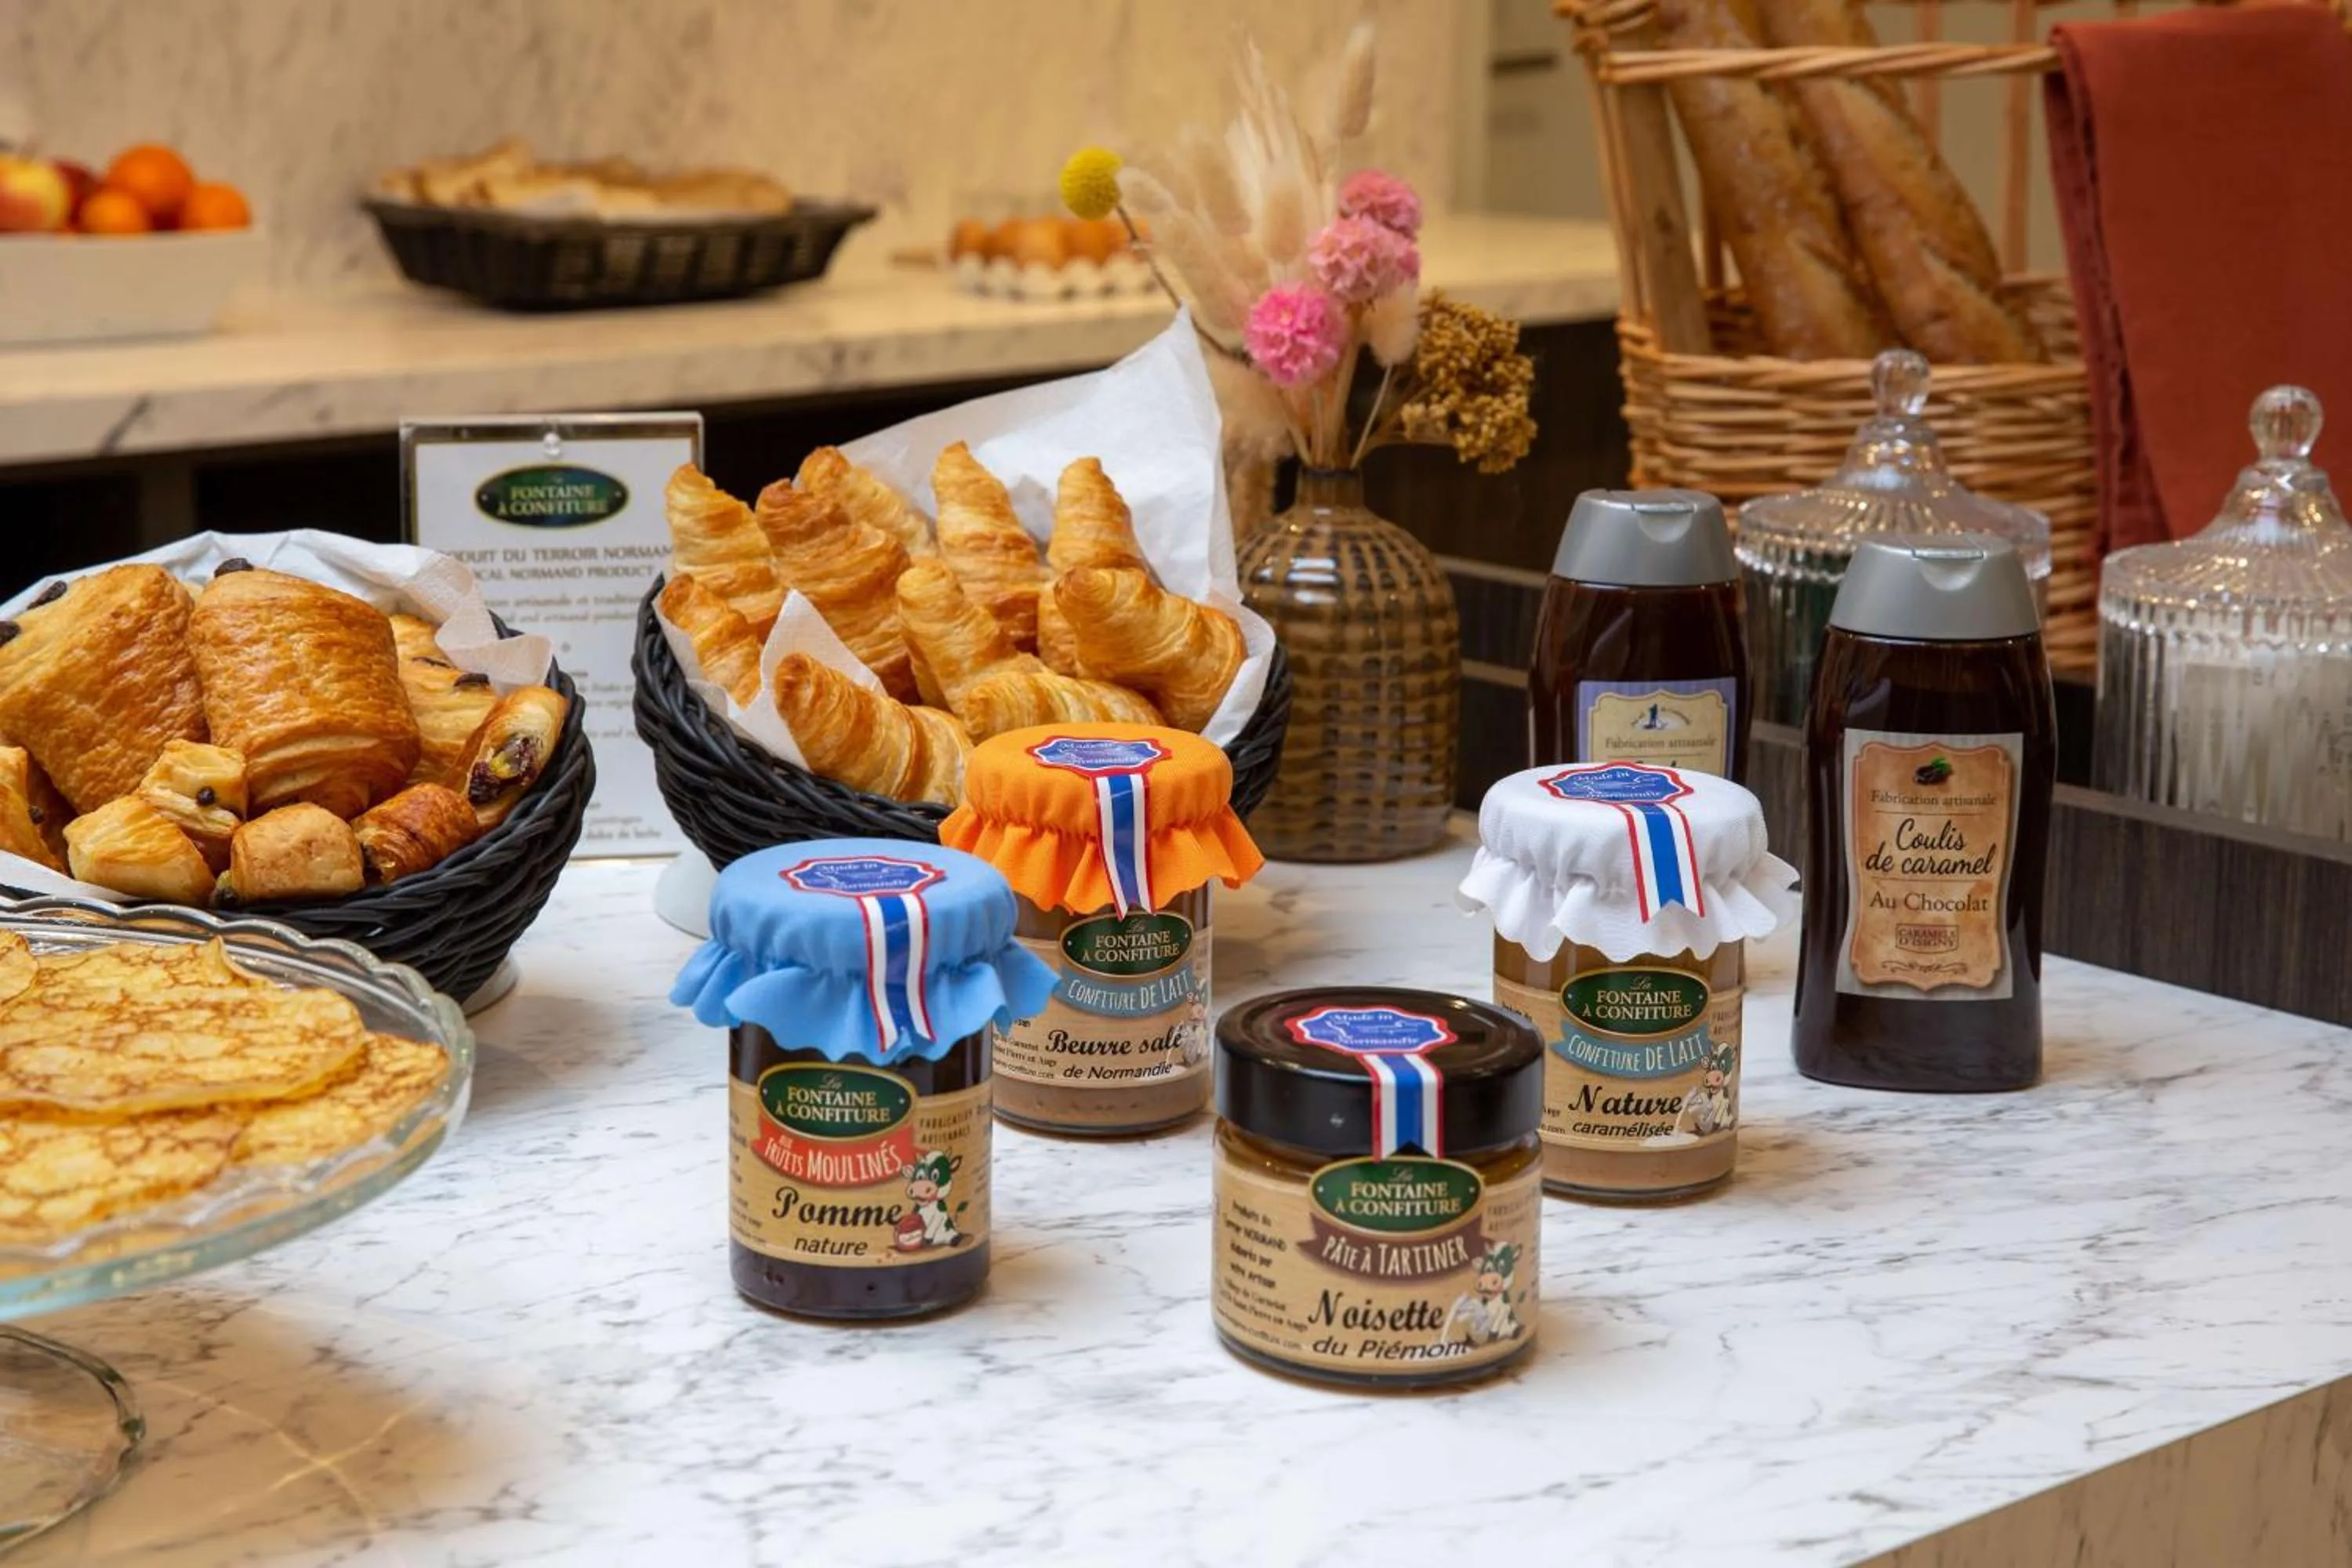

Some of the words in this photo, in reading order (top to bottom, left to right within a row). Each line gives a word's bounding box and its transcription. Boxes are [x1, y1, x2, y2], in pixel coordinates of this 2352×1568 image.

[511, 485, 596, 499] FONTAINE
[511, 499, 608, 515] CONFITURE
[503, 548, 526, 562] DU
[532, 546, 597, 561] TERROIR
[603, 543, 673, 561] NORMAN
[510, 566, 584, 580] NORMAND
[587, 564, 653, 579] PRODUCT
[1605, 735, 1664, 749] Fabrication
[1669, 735, 1717, 748] artisanale
[1870, 789, 1939, 806] Fabrication
[1942, 793, 1997, 807] artisanale
[1896, 818, 1965, 851] Coulis
[1865, 841, 1894, 873] de
[1901, 842, 1997, 875] caramel
[1869, 891, 1896, 909] Au
[1904, 892, 1988, 911] Chocolat
[1095, 931, 1171, 949] FONTAINE
[1094, 943, 1180, 962] CONFITURE
[1067, 979, 1136, 1011] CONFITURE
[1141, 984, 1159, 1009] DE
[1160, 969, 1191, 1004] LAIT
[1596, 990, 1681, 1004] FONTAINE
[1581, 1003, 1592, 1018] À
[1595, 1004, 1693, 1020] CONFITURE
[1045, 1029, 1132, 1055] Beurre
[1138, 1025, 1183, 1054] salé
[1568, 1033, 1641, 1073] CONFITURE
[1646, 1046, 1665, 1072] DE
[1668, 1033, 1706, 1067] LAIT
[1063, 1064, 1084, 1079] de
[1087, 1061, 1173, 1080] Normandie
[787, 1086, 877, 1106] FONTAINE
[1568, 1084, 1683, 1116] Nature
[775, 1100, 783, 1116] À
[786, 1103, 891, 1123] CONFITURE
[1572, 1120, 1675, 1138] caramélisée
[764, 1137, 804, 1176] FRUITS
[807, 1140, 902, 1182] MOULINÉS
[1350, 1181, 1448, 1199] FONTAINE
[772, 1185, 902, 1228] Pomme
[1334, 1196, 1346, 1213] À
[1349, 1197, 1461, 1217] CONFITURE
[794, 1236, 869, 1256] nature
[1322, 1235, 1359, 1270] PÂTE
[1359, 1246, 1371, 1273] À
[1378, 1235, 1469, 1276] TARTINER
[1308, 1289, 1444, 1332] Noisette
[1312, 1336, 1348, 1356] du
[1357, 1338, 1468, 1360] Piémont
